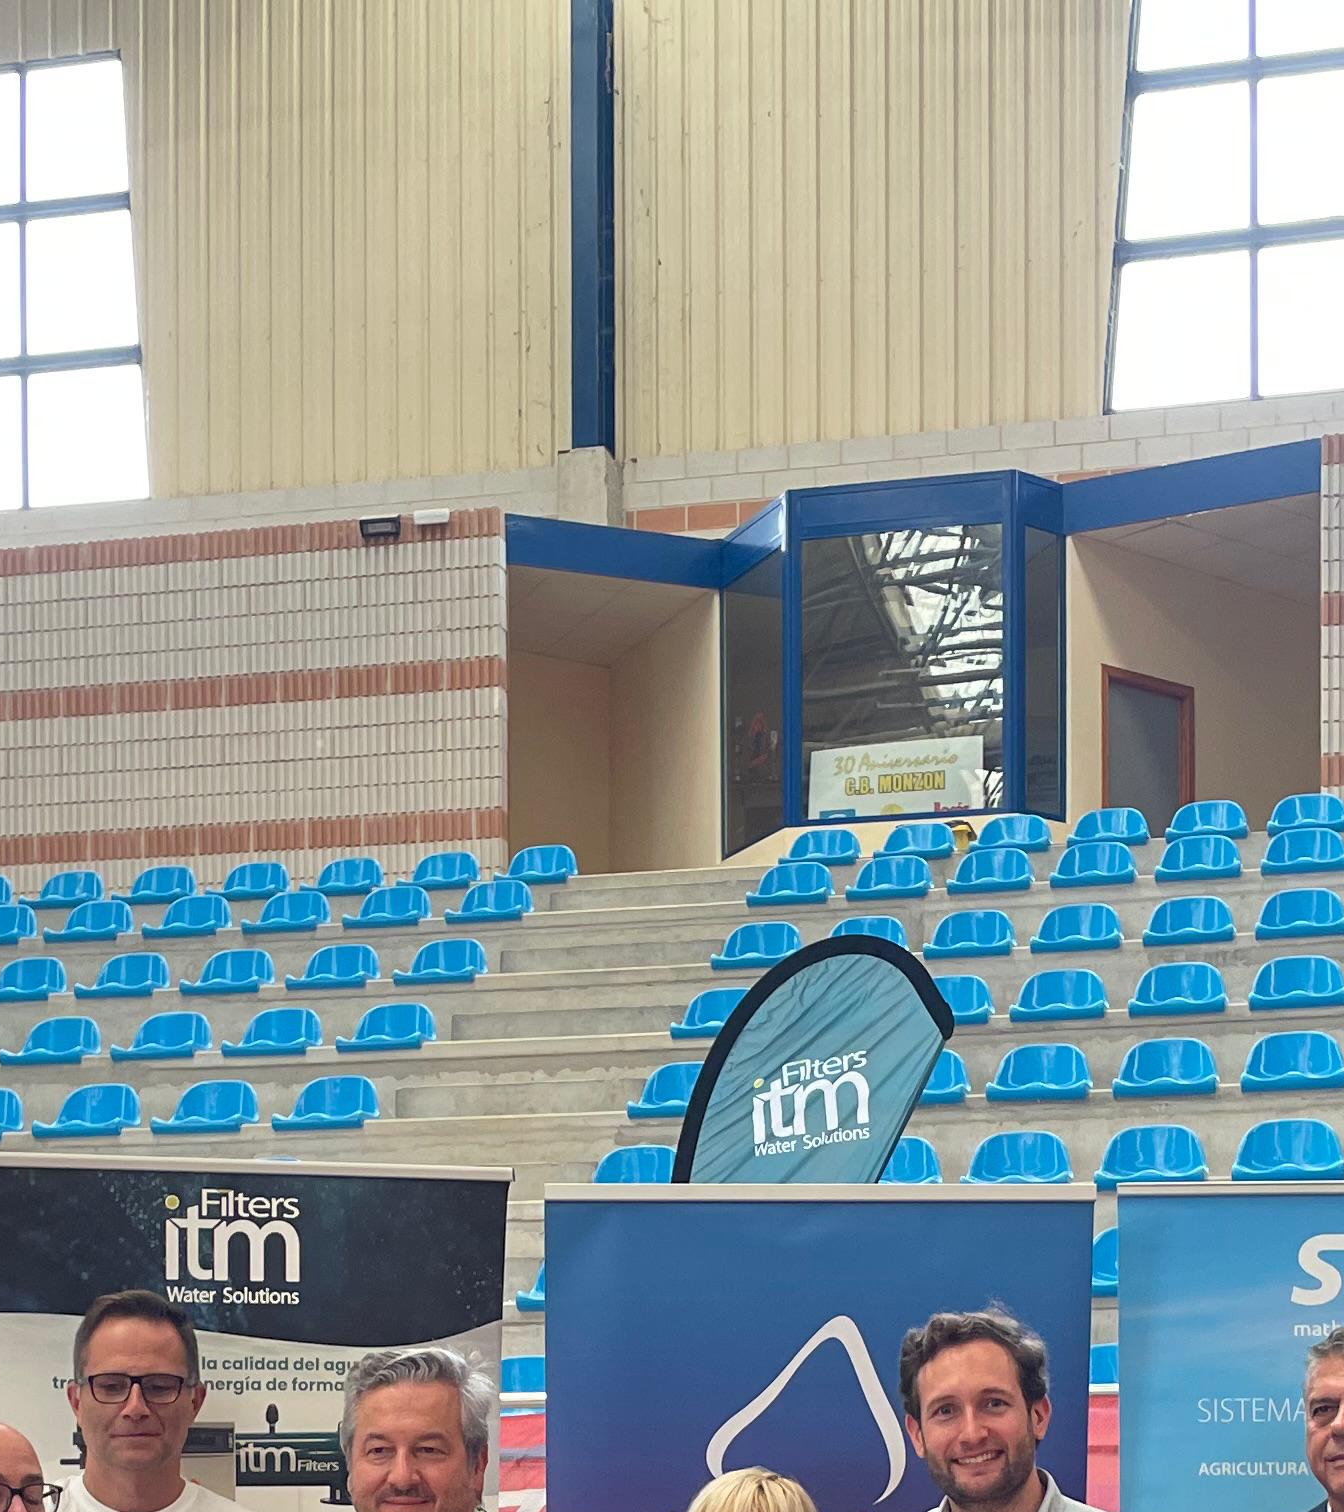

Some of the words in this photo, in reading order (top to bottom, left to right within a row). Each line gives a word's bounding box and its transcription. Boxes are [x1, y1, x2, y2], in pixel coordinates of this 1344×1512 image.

[833, 754, 856, 776] 30
[845, 776, 874, 796] C.B.
[878, 770, 946, 793] MONZON
[782, 1050, 867, 1086] Filters
[752, 1070, 870, 1145] itm
[754, 1140, 797, 1157] Water
[802, 1127, 870, 1150] Solutions
[201, 1188, 300, 1219] Filters
[164, 1194, 301, 1283] itm
[166, 1286, 217, 1303] Water
[222, 1286, 300, 1305] Solutions
[202, 1356, 217, 1370] la
[222, 1355, 288, 1371] calidad
[294, 1355, 320, 1371] del
[203, 1376, 261, 1395] nergía
[266, 1377, 288, 1391] de
[292, 1377, 345, 1391] forma
[1197, 1397, 1306, 1423] SISTEMA
[237, 1442, 297, 1474] itm
[298, 1458, 340, 1473] Filters
[1199, 1461, 1309, 1477] AGRICULTURA
